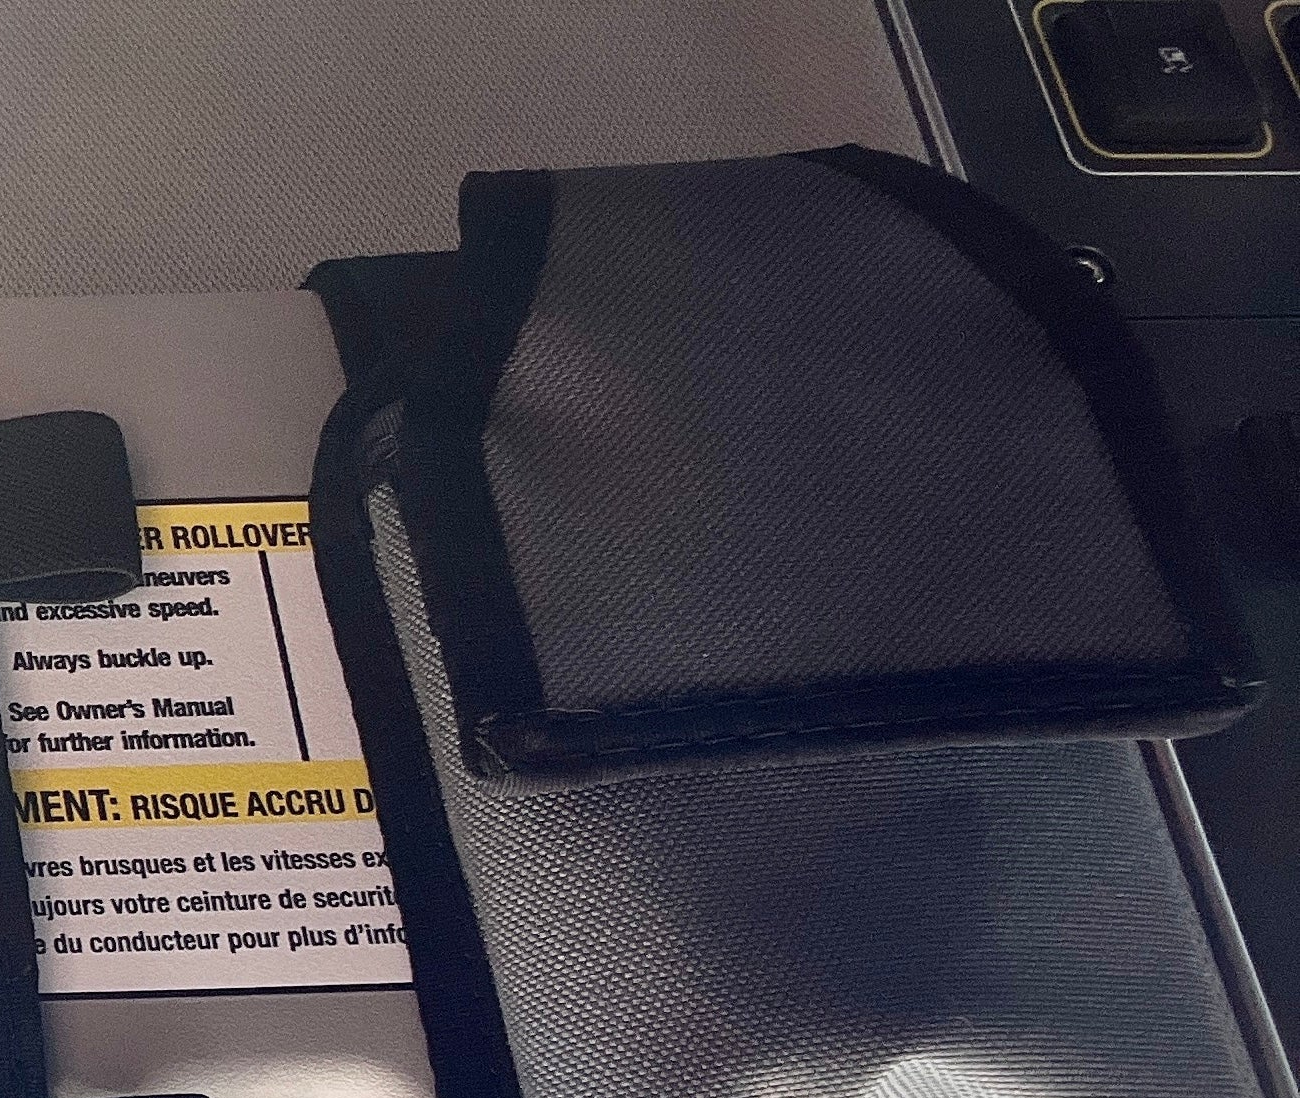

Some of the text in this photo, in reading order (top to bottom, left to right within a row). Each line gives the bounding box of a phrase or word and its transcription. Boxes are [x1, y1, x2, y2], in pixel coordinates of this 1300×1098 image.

[139, 569, 231, 588] neuvers
[36, 600, 141, 621] excessive
[148, 597, 220, 622] speed.
[12, 648, 214, 674] Always buckle up.
[7, 696, 235, 722] See Owner's Manual
[37, 732, 114, 753] further
[120, 728, 256, 751] information.
[14, 788, 375, 824] MENT: RISQUE ACCRU D
[79, 855, 187, 879] brusques
[193, 852, 217, 873] et
[220, 851, 256, 872] les
[260, 849, 357, 871] vitesses
[110, 893, 171, 915] votre
[176, 890, 273, 913] ceinture
[278, 888, 307, 909] de
[313, 885, 397, 909] securit
[53, 933, 83, 954] du
[89, 930, 221, 954] conducteur
[227, 931, 281, 954] pour
[287, 926, 338, 952] plus
